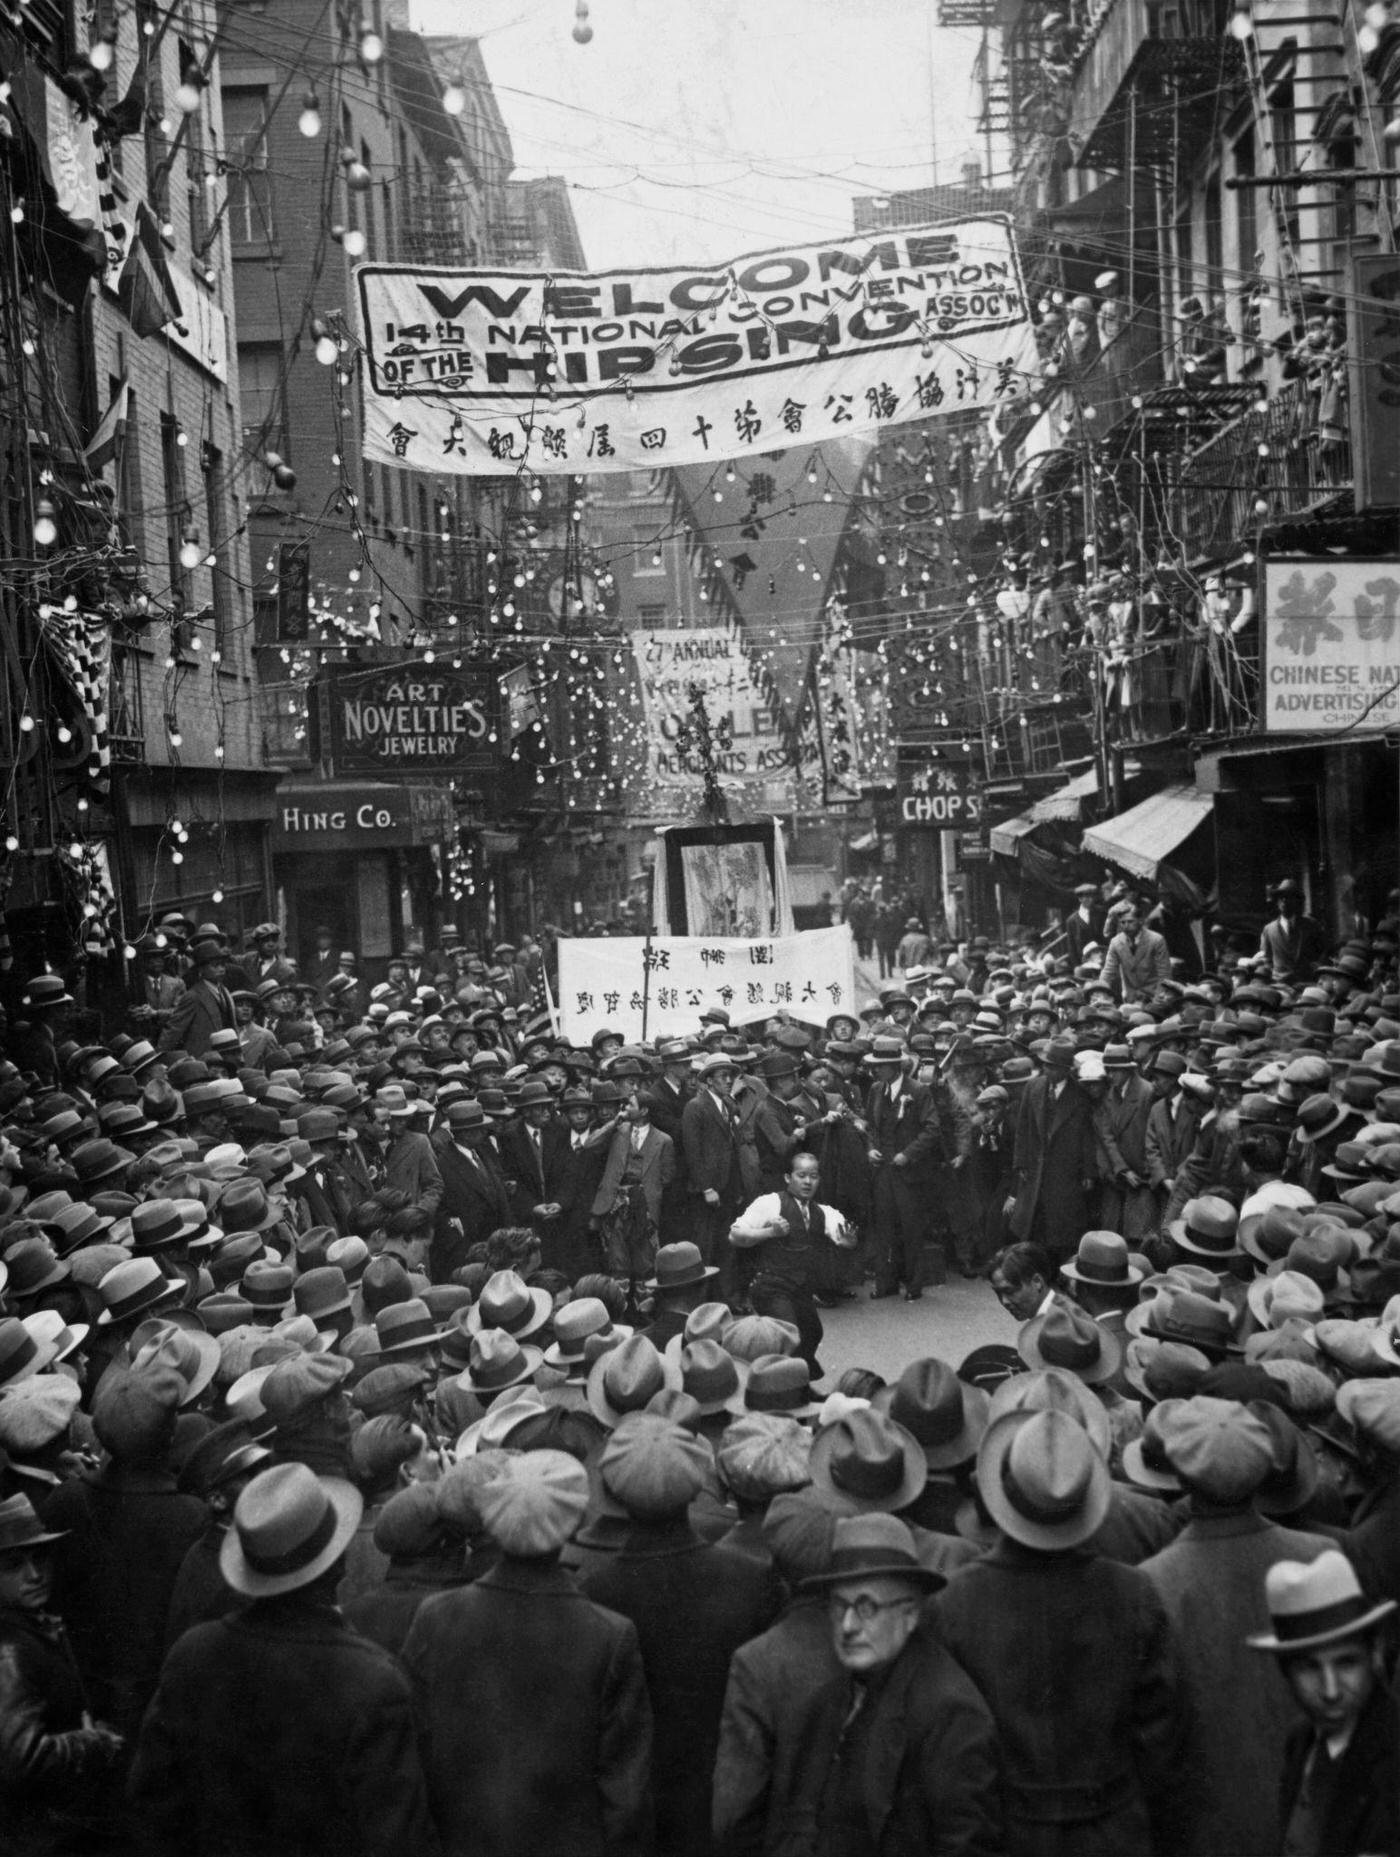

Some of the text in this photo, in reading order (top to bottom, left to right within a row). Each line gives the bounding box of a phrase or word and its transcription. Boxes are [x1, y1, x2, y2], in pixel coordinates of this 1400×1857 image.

[416, 234, 961, 319] WELCOME
[386, 261, 1009, 345] 14th NATIONAL CONVENTION
[383, 360, 415, 383] OF
[421, 351, 474, 376] THE
[485, 346, 656, 384] HIP
[677, 301, 921, 375] SING
[673, 639, 734, 662] ANNUAL
[1270, 665, 1360, 685] CHINESE
[386, 684, 445, 702] ART
[1275, 693, 1396, 712] ADVERTISING
[344, 699, 486, 740] NOVELTIES
[379, 736, 458, 756] JEWELRY
[283, 807, 347, 832] HING
[902, 796, 961, 821] CHOP
